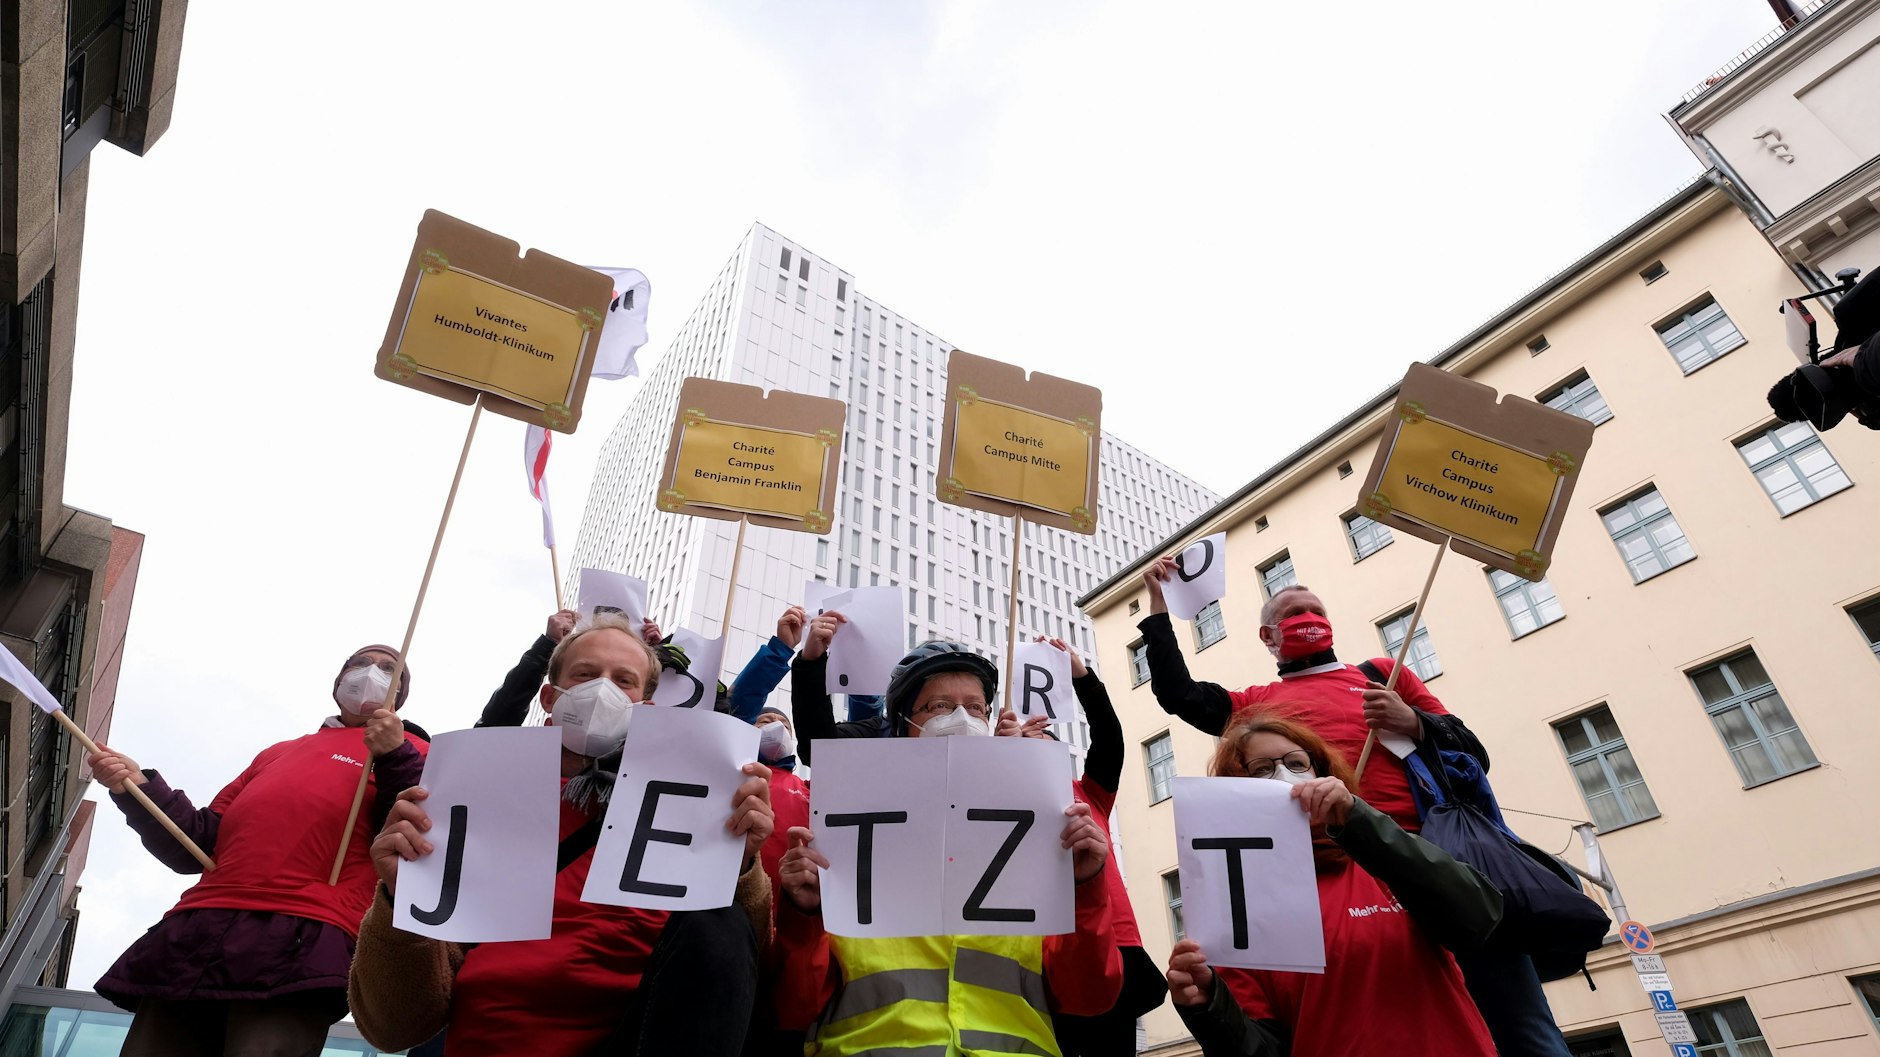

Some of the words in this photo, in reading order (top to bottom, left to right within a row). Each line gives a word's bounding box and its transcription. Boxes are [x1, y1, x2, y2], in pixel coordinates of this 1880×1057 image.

[475, 306, 528, 333] Vivantes
[434, 313, 555, 362] Humboldt-Klinikum
[732, 441, 775, 456] Charité
[1004, 430, 1044, 449] Charité
[728, 457, 775, 472] Campus
[984, 444, 1028, 463] Campus
[1031, 455, 1061, 472] Mitte
[1450, 449, 1499, 474] Charité
[694, 468, 751, 486] Benjamin
[754, 478, 802, 493] Franklin
[1441, 468, 1494, 494] Campus
[1405, 474, 1458, 502] Virchow
[1460, 495, 1519, 526] Klinikum
[1022, 663, 1057, 720] R
[331, 753, 355, 764] Mehr
[618, 779, 710, 898] E
[410, 804, 468, 926] J
[824, 810, 908, 925] T
[962, 808, 1036, 923] Z
[1191, 836, 1274, 951] T
[1348, 904, 1379, 918] Mehr
[1655, 992, 1668, 1010] P
